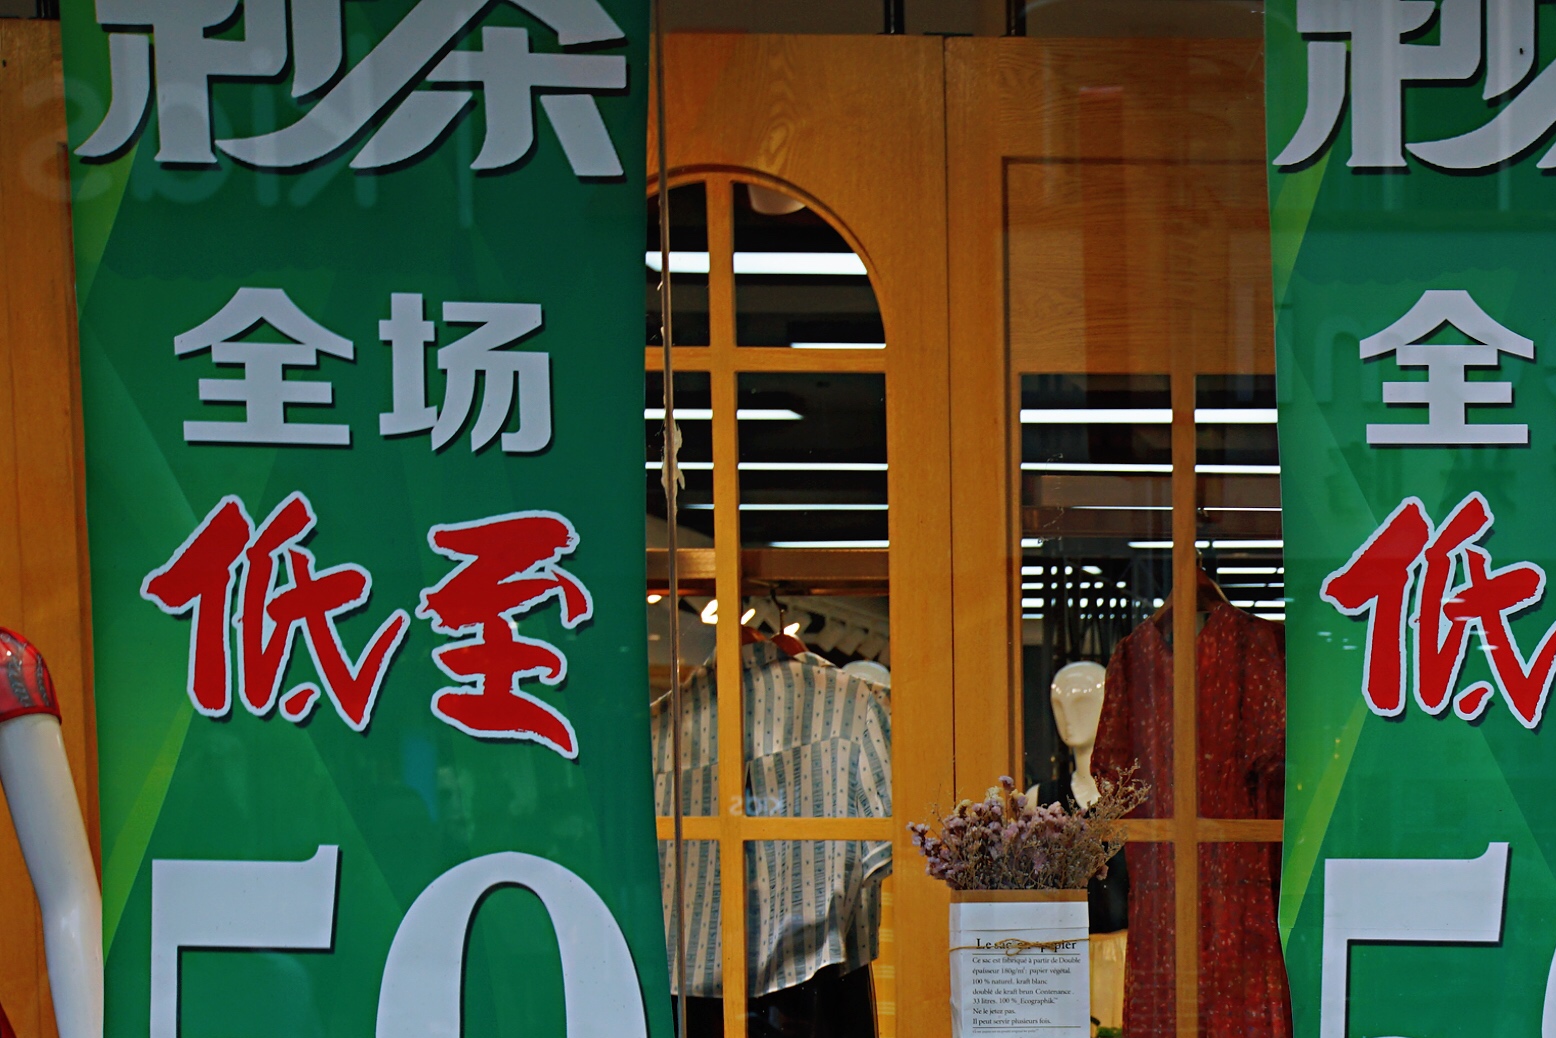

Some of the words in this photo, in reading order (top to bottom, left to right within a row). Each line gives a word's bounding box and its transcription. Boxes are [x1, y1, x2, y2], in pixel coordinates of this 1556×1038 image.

[174, 288, 552, 453] 全场
[140, 491, 593, 762] 低至
[1029, 967, 1048, 975] papier
